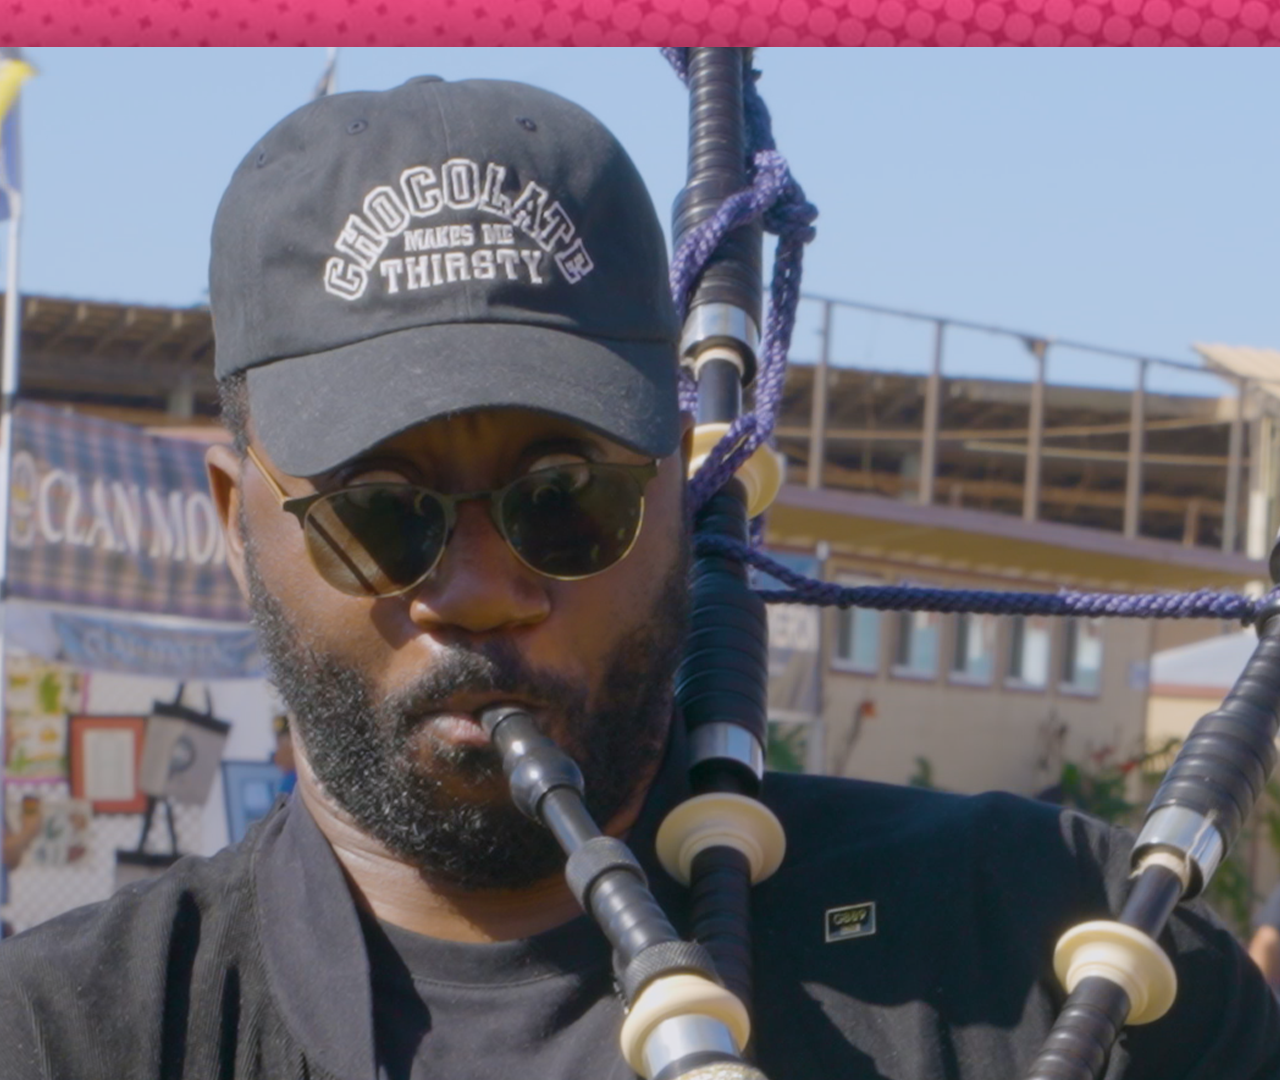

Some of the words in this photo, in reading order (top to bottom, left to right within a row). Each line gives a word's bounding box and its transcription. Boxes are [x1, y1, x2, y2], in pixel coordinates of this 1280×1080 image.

[322, 157, 595, 301] CHOCOLATE
[403, 222, 475, 252] MAKES
[481, 221, 515, 246] ME
[379, 248, 544, 294] THIRSTY
[39, 468, 142, 554] CLAN
